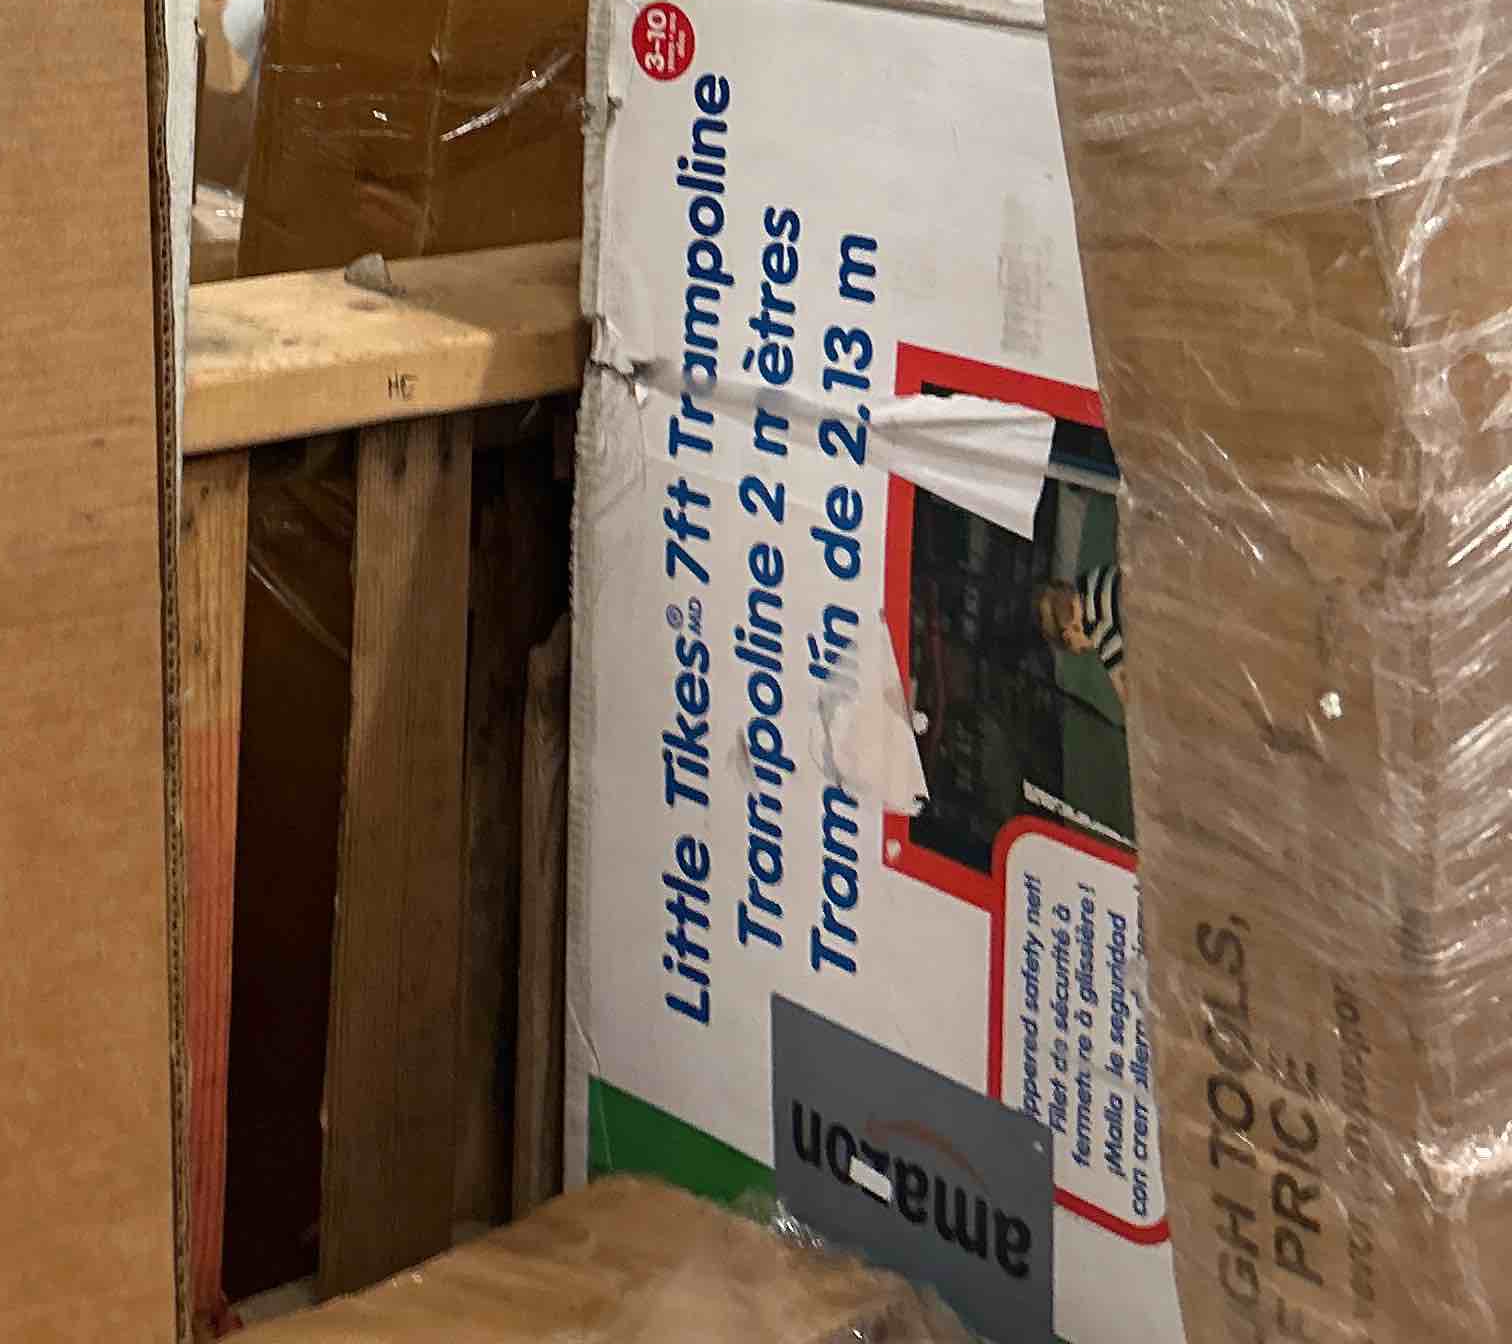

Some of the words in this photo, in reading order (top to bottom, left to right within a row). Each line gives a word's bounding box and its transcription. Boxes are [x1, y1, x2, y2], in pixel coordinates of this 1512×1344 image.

[645, 9, 667, 73] 3-10
[668, 72, 735, 459] Trampoline
[838, 232, 878, 304] m
[817, 325, 874, 466] 2.13
[663, 476, 713, 585] 7ft
[739, 474, 785, 525] 2
[810, 483, 863, 581] de
[663, 834, 710, 1026] Little
[1268, 1053, 1323, 1287] PRICE
